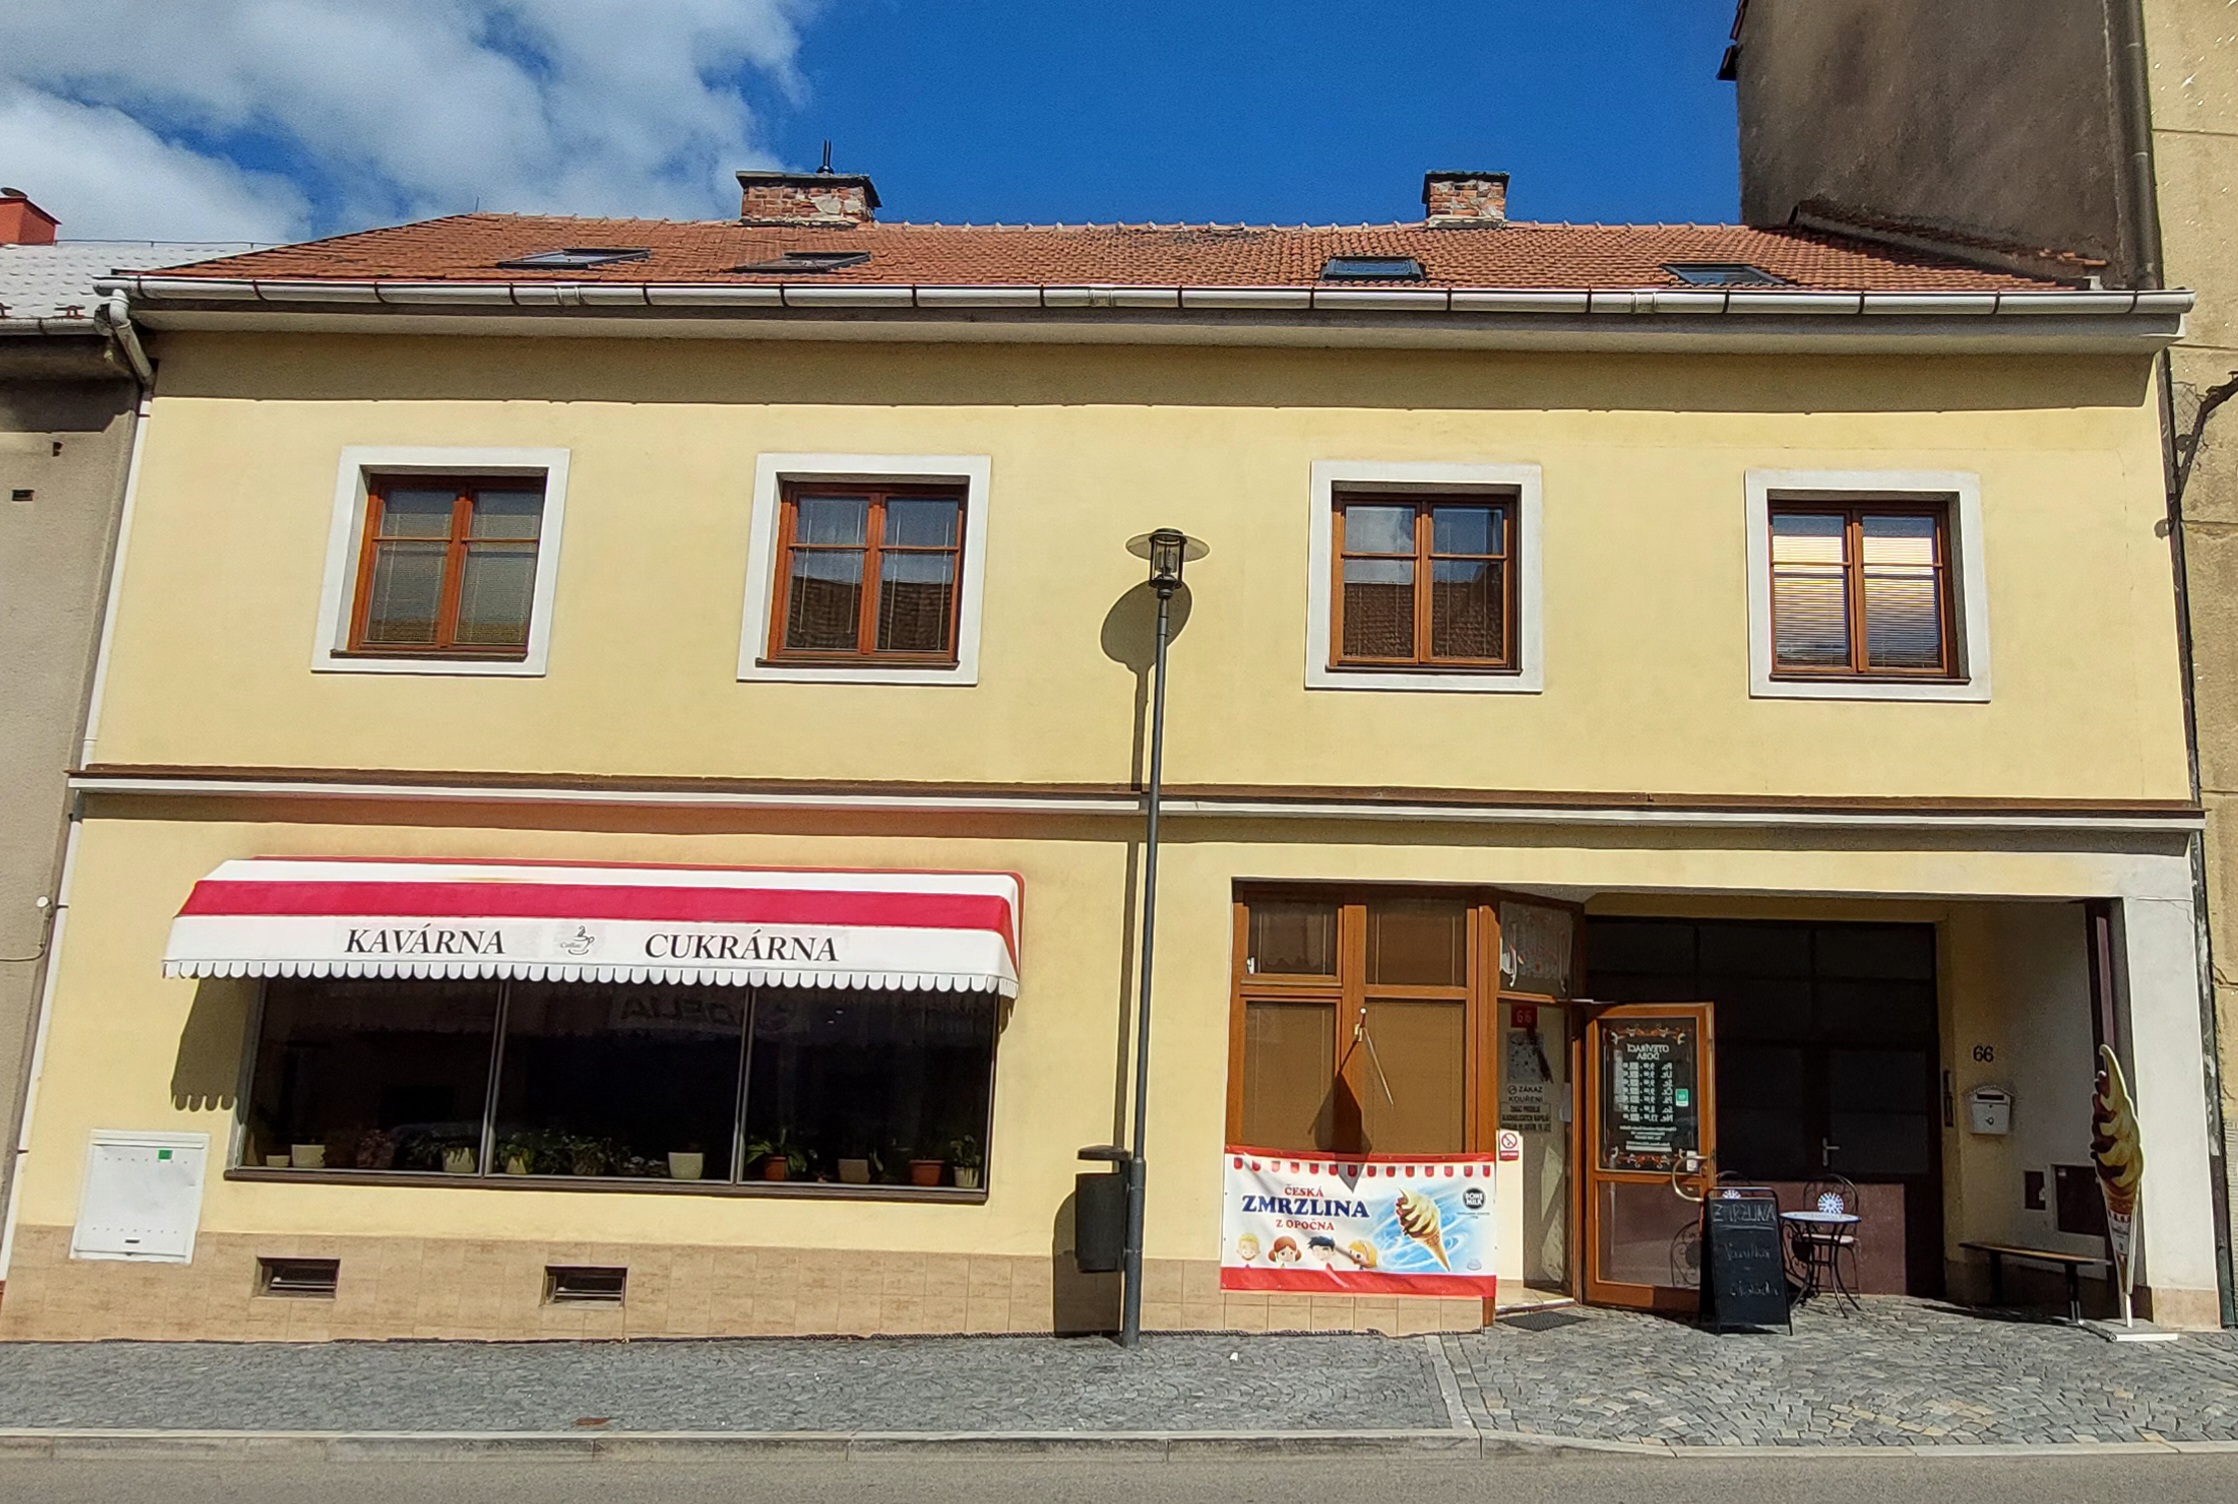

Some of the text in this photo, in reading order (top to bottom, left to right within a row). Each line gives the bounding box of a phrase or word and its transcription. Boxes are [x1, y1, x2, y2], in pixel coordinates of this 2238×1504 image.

[343, 924, 506, 955] KAVÁRNA
[645, 929, 839, 962] CUKRÁRNA
[1516, 1009, 1532, 1024] 66
[1972, 1045, 1995, 1063] 66
[1518, 1085, 1543, 1093] ZÁKAZ
[1284, 1184, 1324, 1197] ČESKÁ
[1242, 1195, 1370, 1218] ZMRZLINA
[1275, 1218, 1335, 1231] Z OPOČNA
